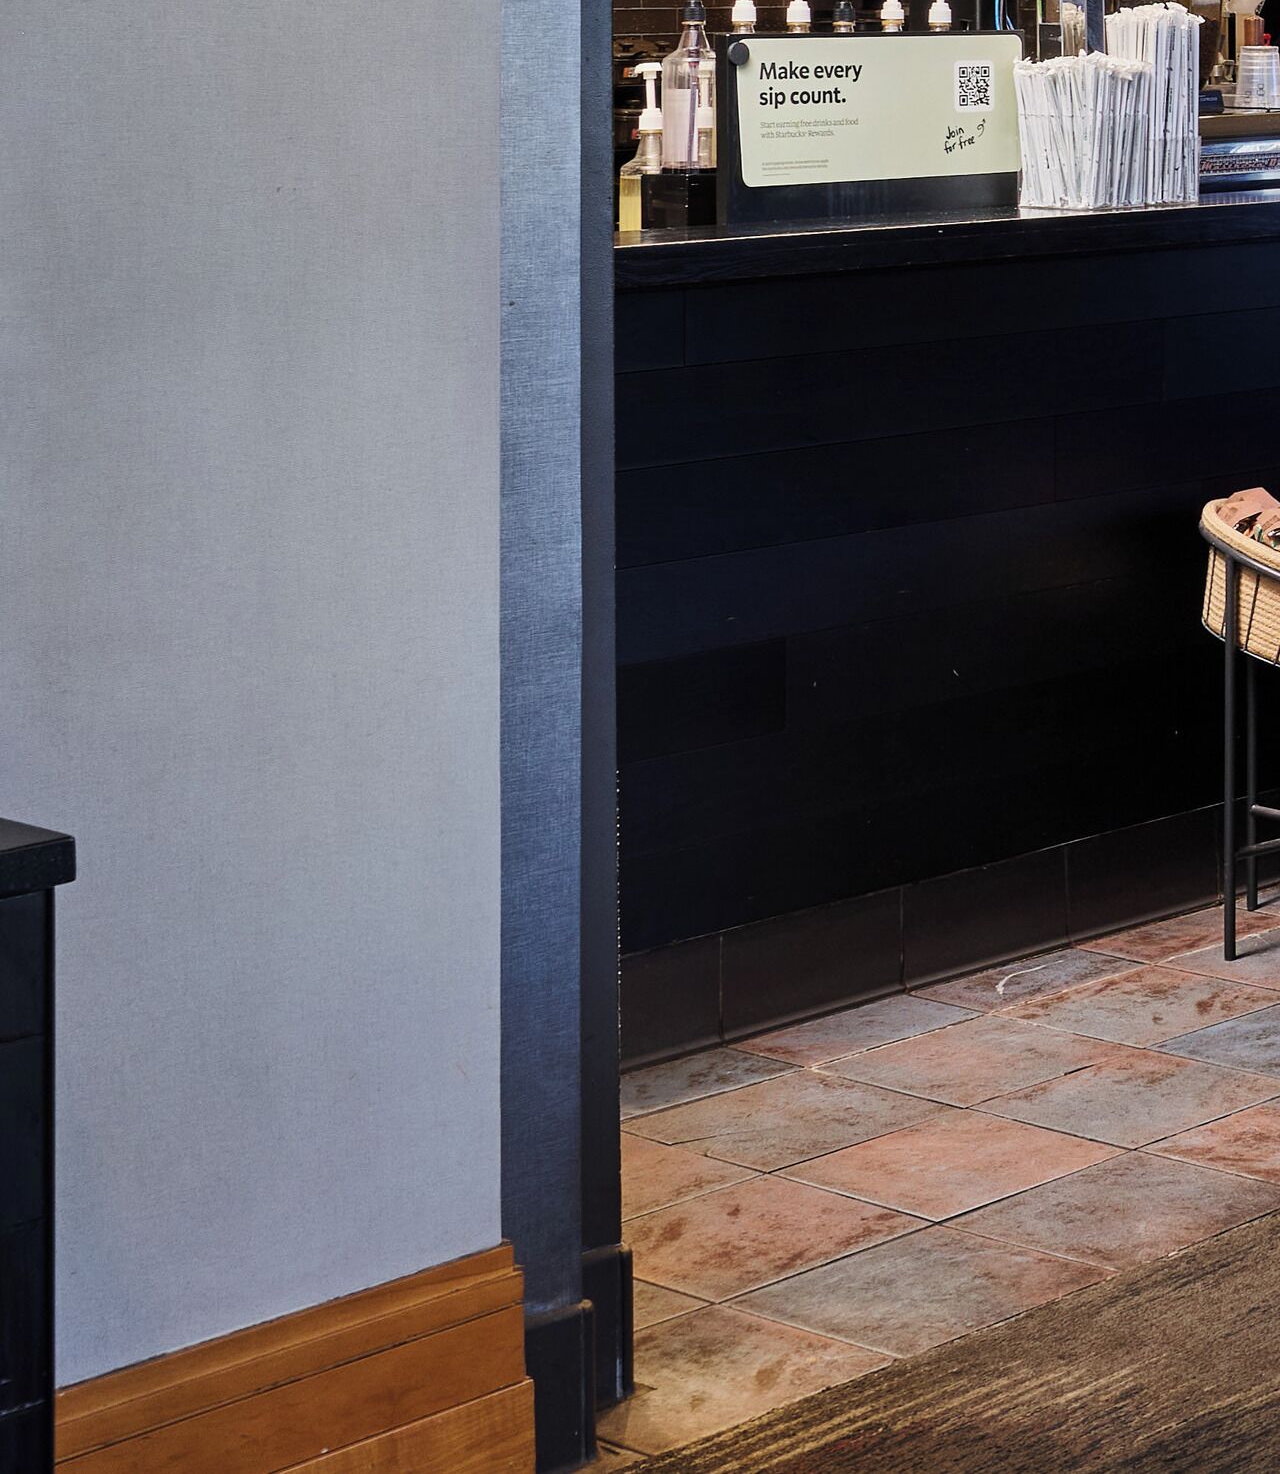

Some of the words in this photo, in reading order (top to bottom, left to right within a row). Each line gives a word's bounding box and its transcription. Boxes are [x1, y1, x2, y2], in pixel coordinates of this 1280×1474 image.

[760, 61, 809, 79] Make
[814, 65, 862, 82] every
[760, 87, 785, 109] sip
[790, 87, 846, 104] count.
[946, 126, 964, 139] Join
[944, 140, 957, 154] for
[958, 136, 975, 150] free
